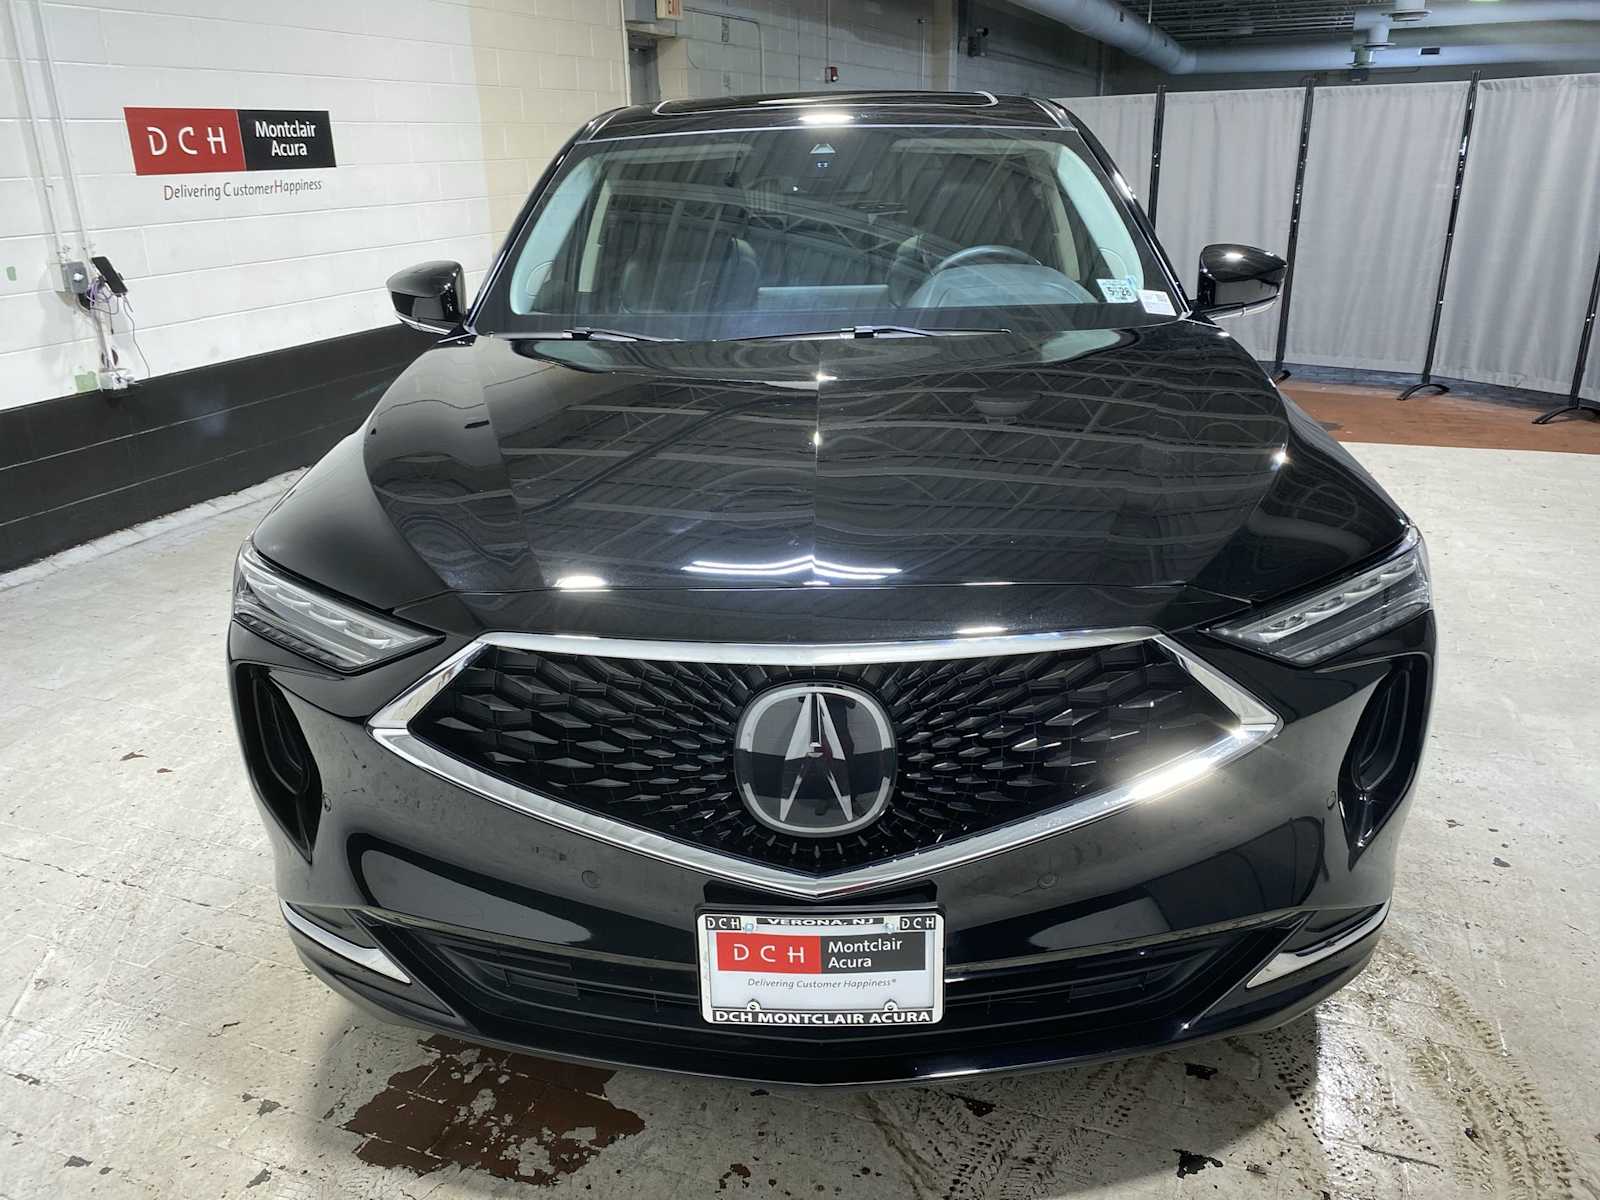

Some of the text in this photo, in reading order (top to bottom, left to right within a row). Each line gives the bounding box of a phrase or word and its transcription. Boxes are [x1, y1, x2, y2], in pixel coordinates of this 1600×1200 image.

[255, 120, 317, 138] Montclair
[271, 140, 308, 156] Acura
[163, 179, 322, 201] Delivering Customer Happiness
[706, 917, 741, 930] DCH
[852, 917, 875, 926] NJ
[901, 916, 936, 930] DCH
[827, 938, 903, 954] Montclair
[827, 955, 873, 969] Acura
[747, 977, 795, 990] Delivering
[796, 978, 842, 990] Customer
[714, 1011, 932, 1025] DCH MONTCLAIR ACURA
